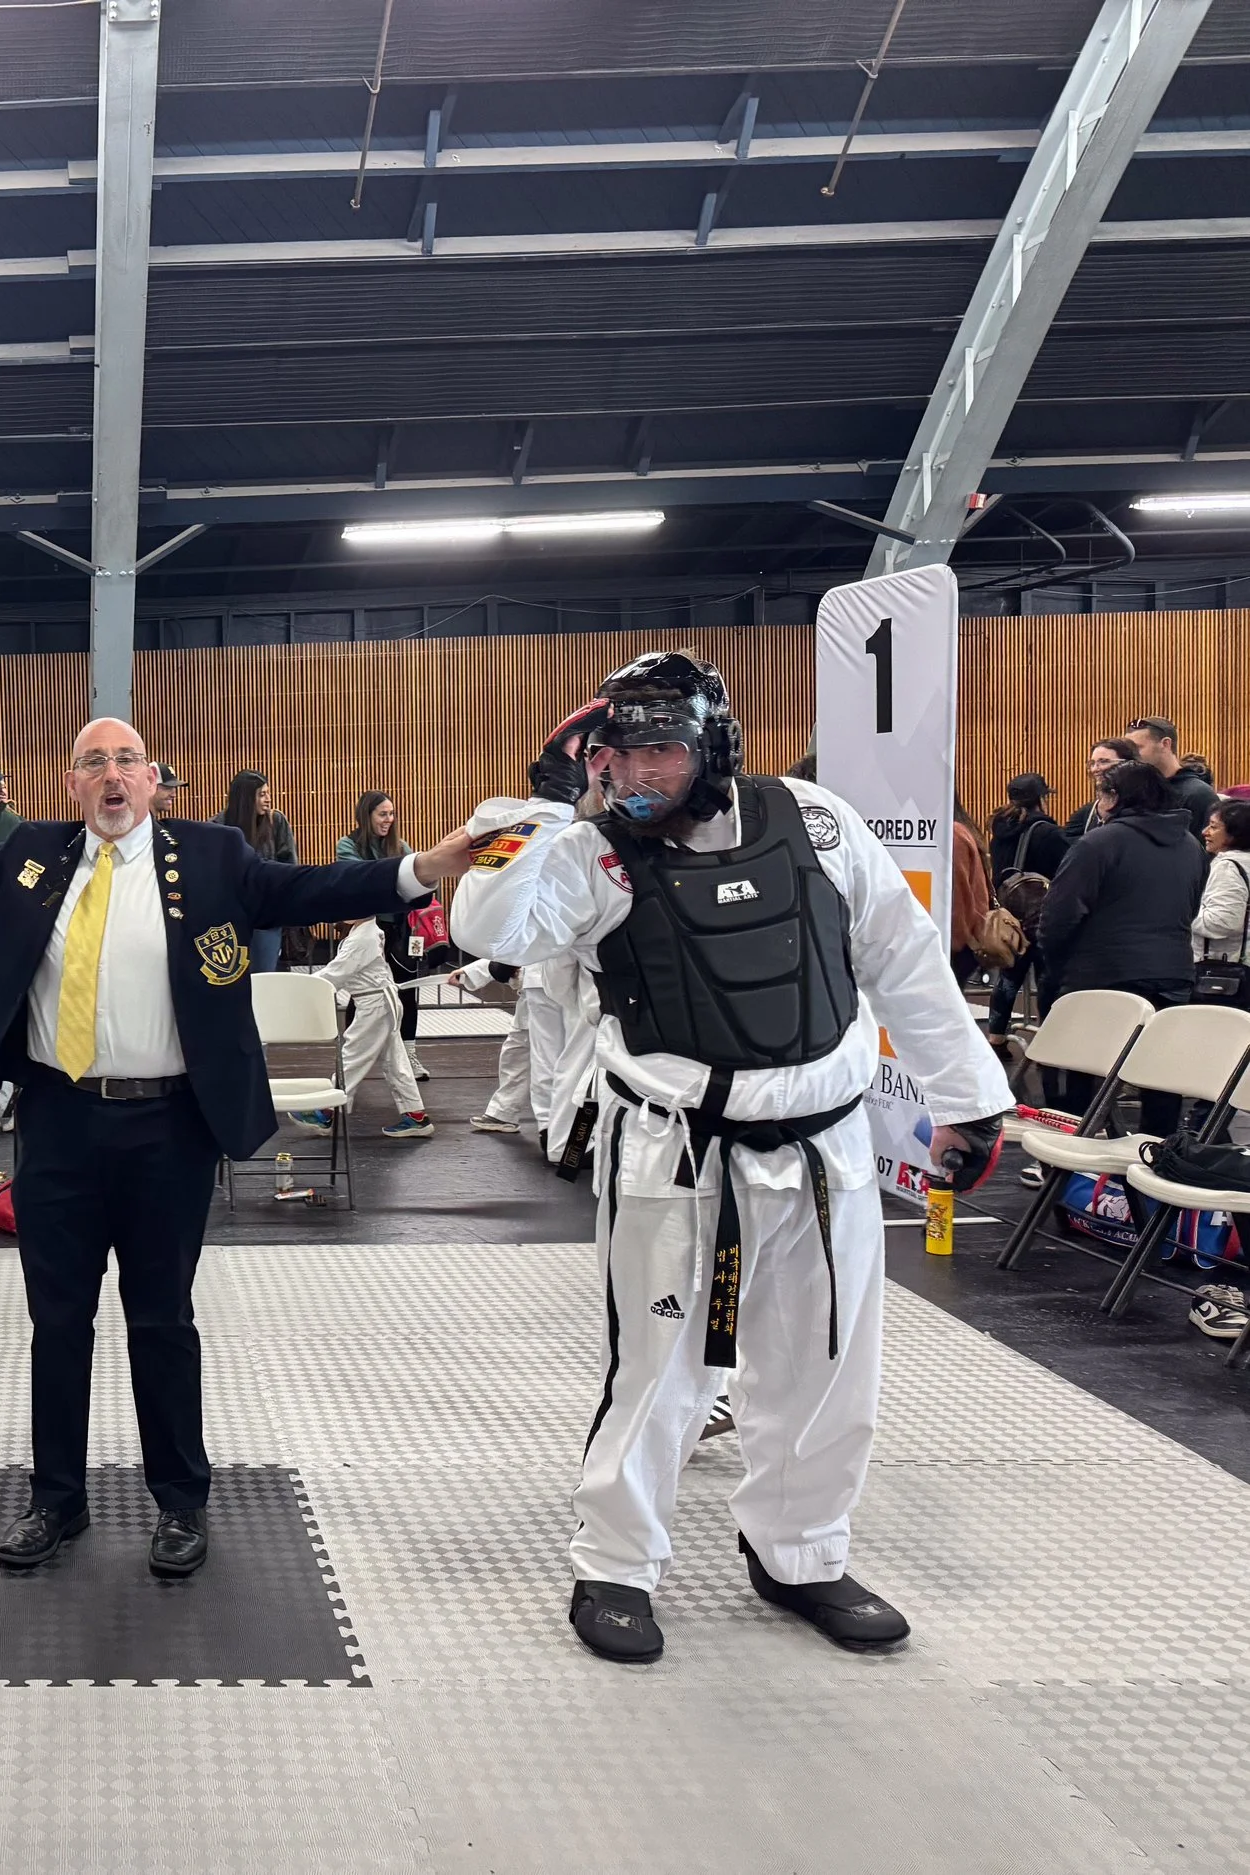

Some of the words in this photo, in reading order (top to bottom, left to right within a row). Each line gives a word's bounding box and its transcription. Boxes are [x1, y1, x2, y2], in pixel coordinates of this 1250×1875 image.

[865, 617, 893, 734] 1
[863, 819, 914, 840] SORED
[917, 819, 937, 840] BY
[212, 942, 234, 964] ATA
[874, 1154, 893, 1177] 07
[650, 1305, 685, 1320] adidas
